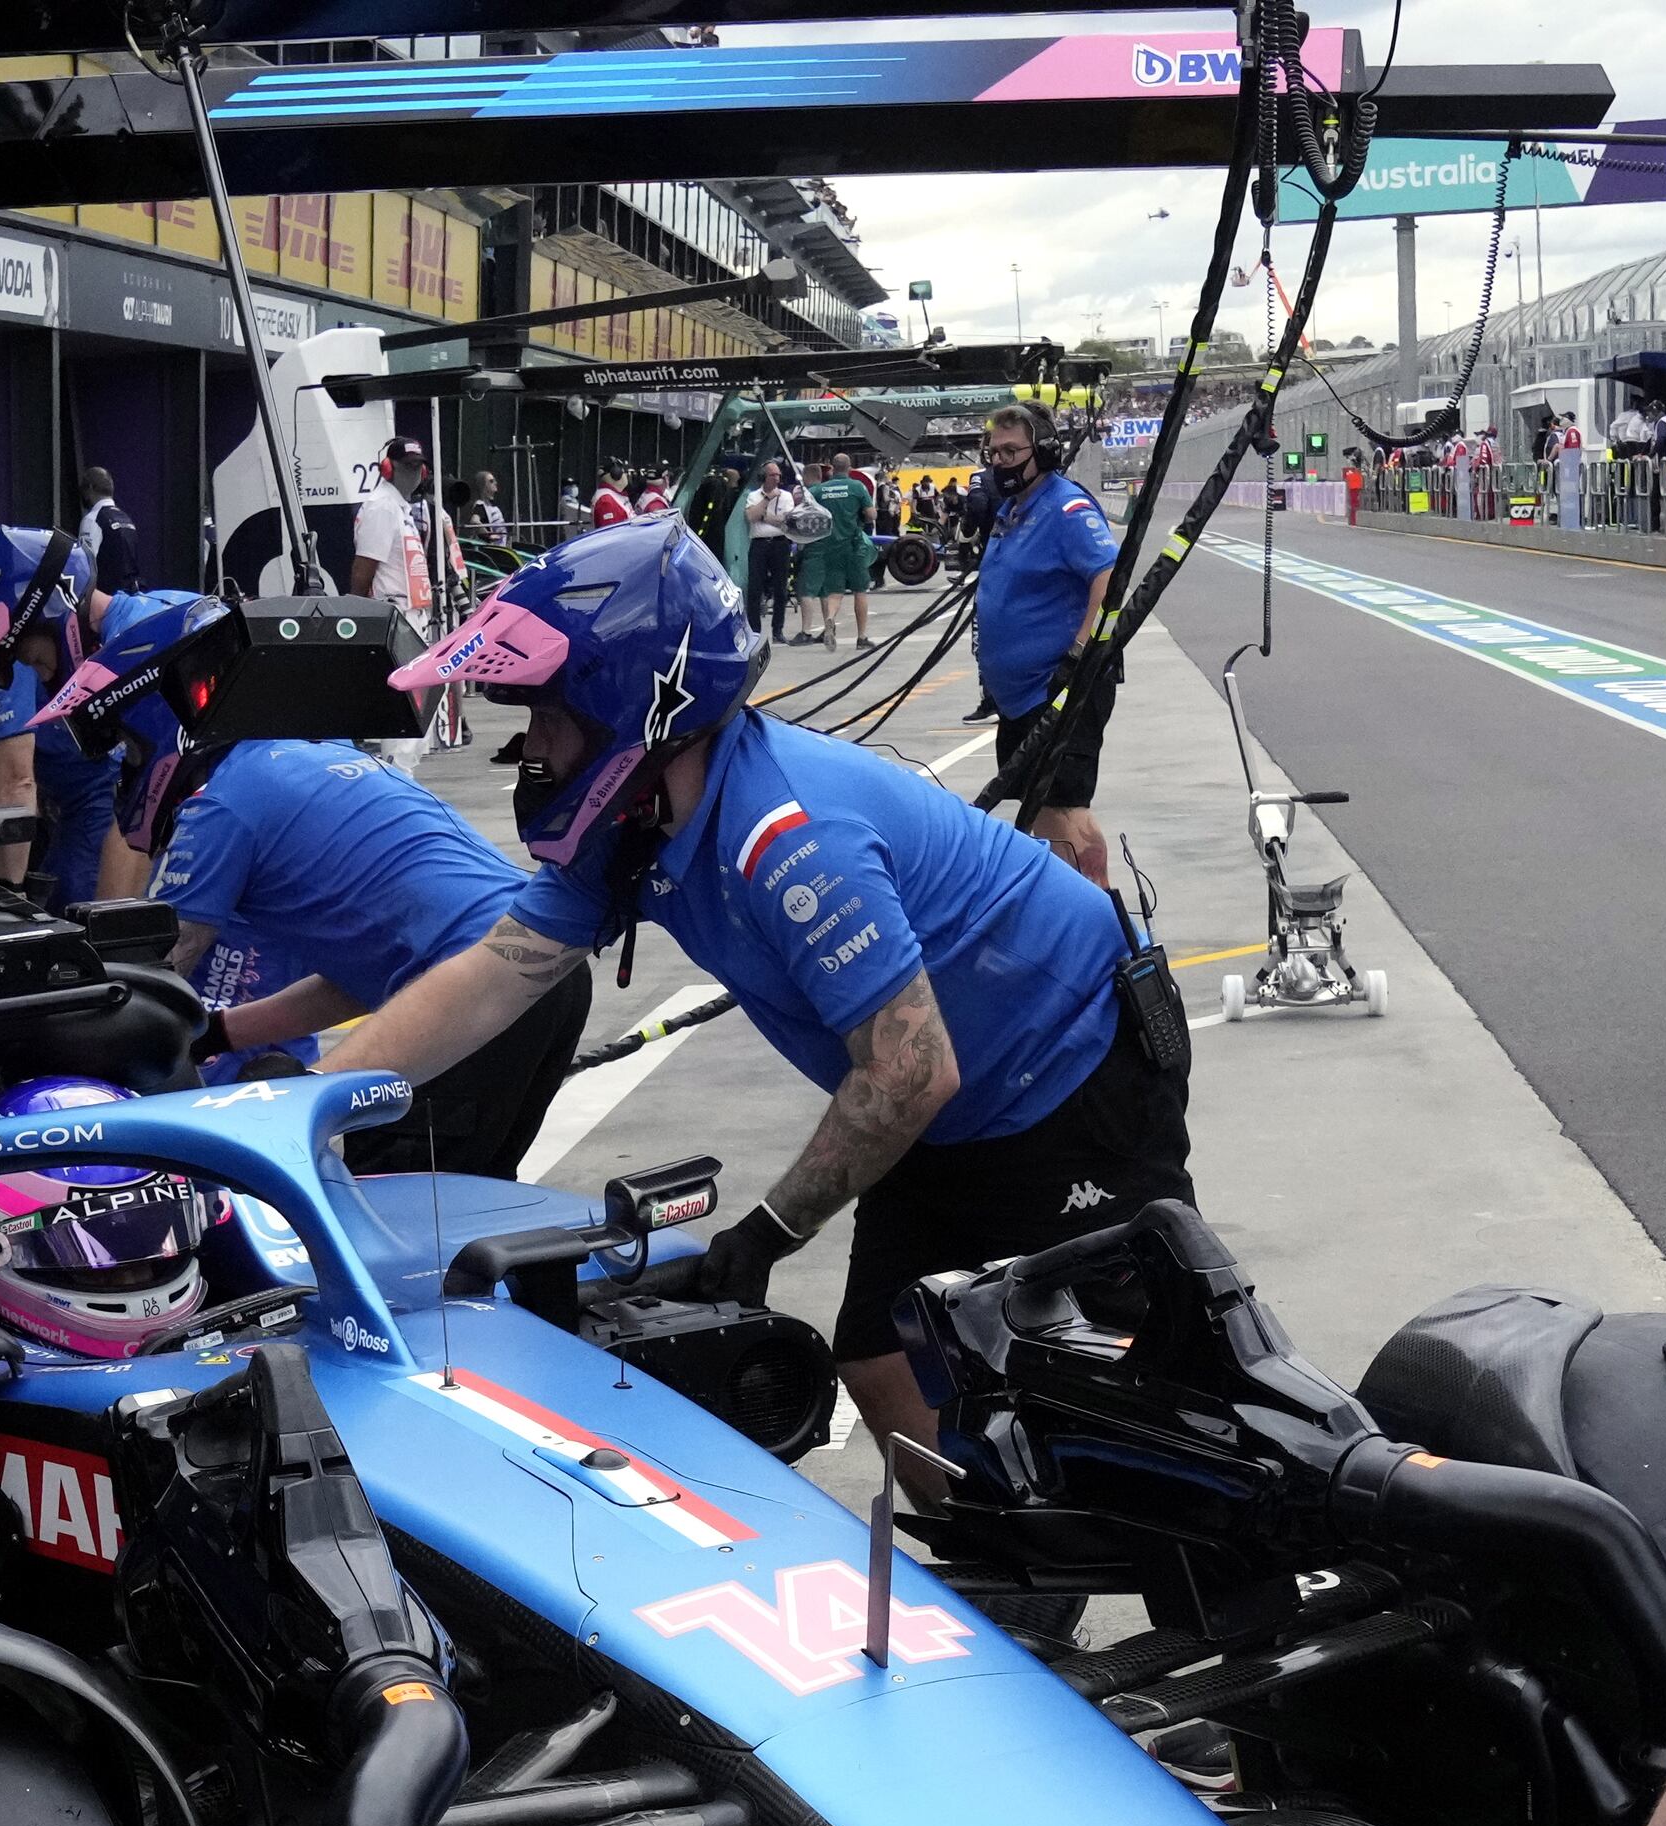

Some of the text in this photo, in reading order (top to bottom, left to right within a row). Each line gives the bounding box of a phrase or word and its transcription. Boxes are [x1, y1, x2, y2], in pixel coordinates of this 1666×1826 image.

[1178, 51, 1242, 85] BW
[1351, 153, 1498, 191] Australia
[219, 297, 231, 341] 10
[583, 364, 720, 386] alphataurif1.com
[809, 402, 851, 413] aramco
[900, 397, 941, 408] MARTIN
[949, 393, 1000, 405] cognizant
[1123, 419, 1162, 435] BWT
[13, 587, 44, 636] shamir
[449, 631, 486, 670] BWT
[56, 681, 78, 706] BWT
[104, 665, 161, 707] shamir
[153, 763, 172, 795] BINANCE
[600, 755, 633, 798] BINANCE
[764, 839, 820, 890] MAPFRE
[809, 872, 826, 887] BANK
[815, 879, 827, 893] AND
[818, 875, 844, 897] SERVICES
[806, 913, 841, 946] PIRELLI
[835, 922, 881, 965] BWT
[215, 949, 244, 1012] WORLD
[51, 1183, 190, 1225] ALPINE
[666, 1196, 706, 1223] Castrol
[7, 1218, 33, 1234] Castrol
[357, 1328, 390, 1353] Ross
[632, 1559, 976, 1697] 14
